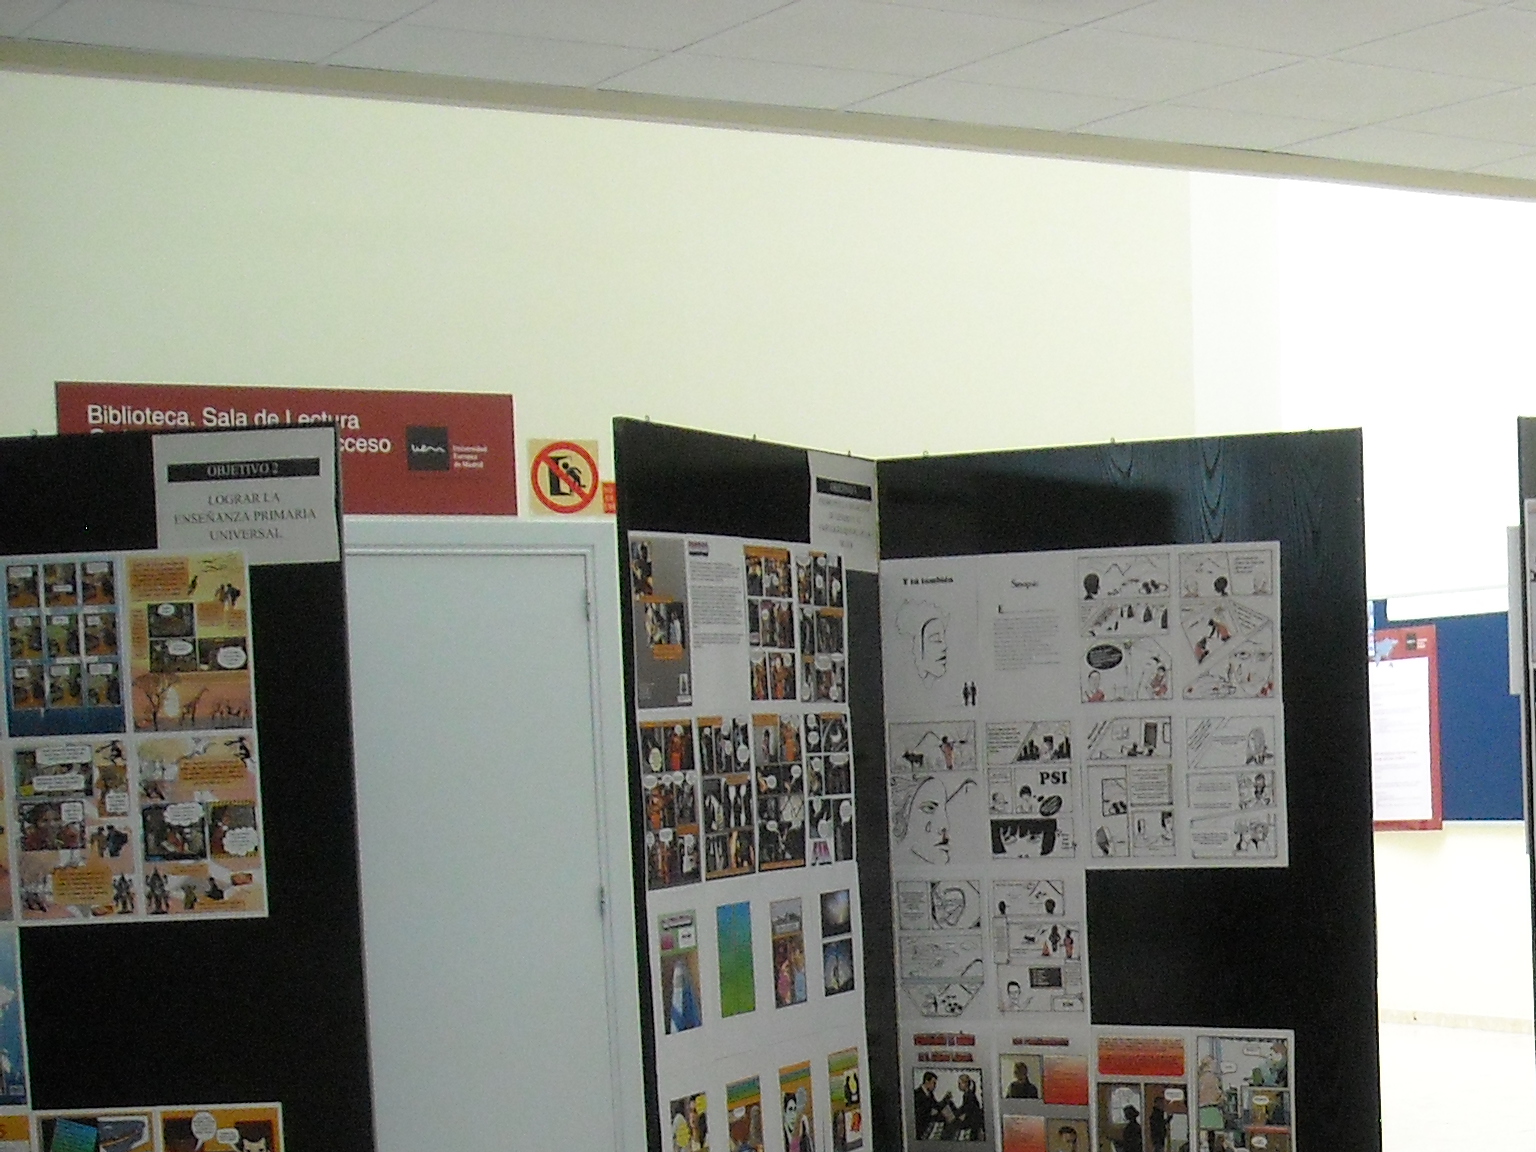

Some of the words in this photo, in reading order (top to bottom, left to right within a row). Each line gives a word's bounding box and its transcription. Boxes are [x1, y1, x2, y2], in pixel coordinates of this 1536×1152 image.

[87, 404, 195, 425] Biblioteca.
[202, 406, 247, 427] Sala
[207, 463, 270, 477] OBJETIVO
[208, 493, 260, 506] LOGRAR
[263, 492, 281, 503] LA
[174, 511, 250, 525] ENSEÑANZA
[253, 508, 317, 522] PRIMARIA
[209, 527, 283, 541] UNIVERSAL
[1039, 771, 1068, 785] PSI
